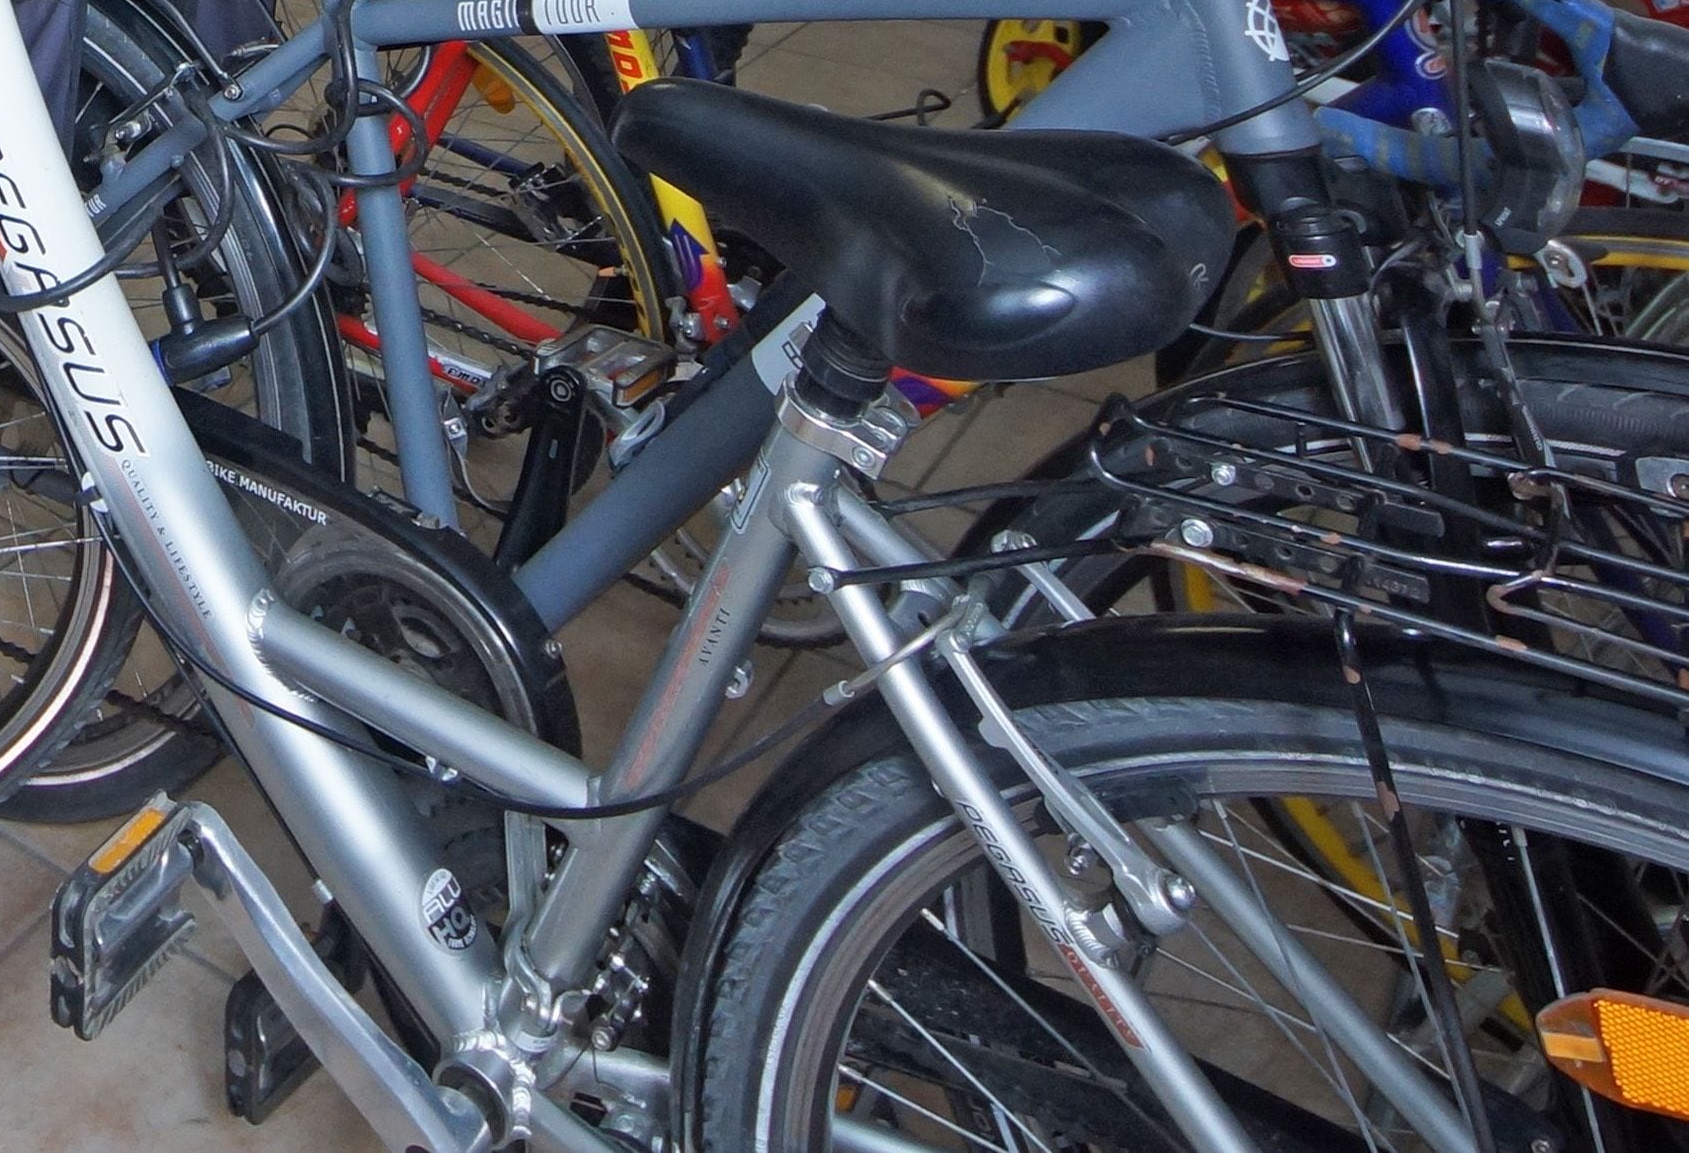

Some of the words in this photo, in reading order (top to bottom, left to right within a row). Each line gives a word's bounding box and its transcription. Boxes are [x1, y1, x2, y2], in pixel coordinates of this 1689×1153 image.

[121, 459, 160, 521] QUALITY
[165, 541, 212, 620] LIFESTYLE
[698, 607, 731, 666] AVANTI
[956, 800, 1073, 946] PEGASUS
